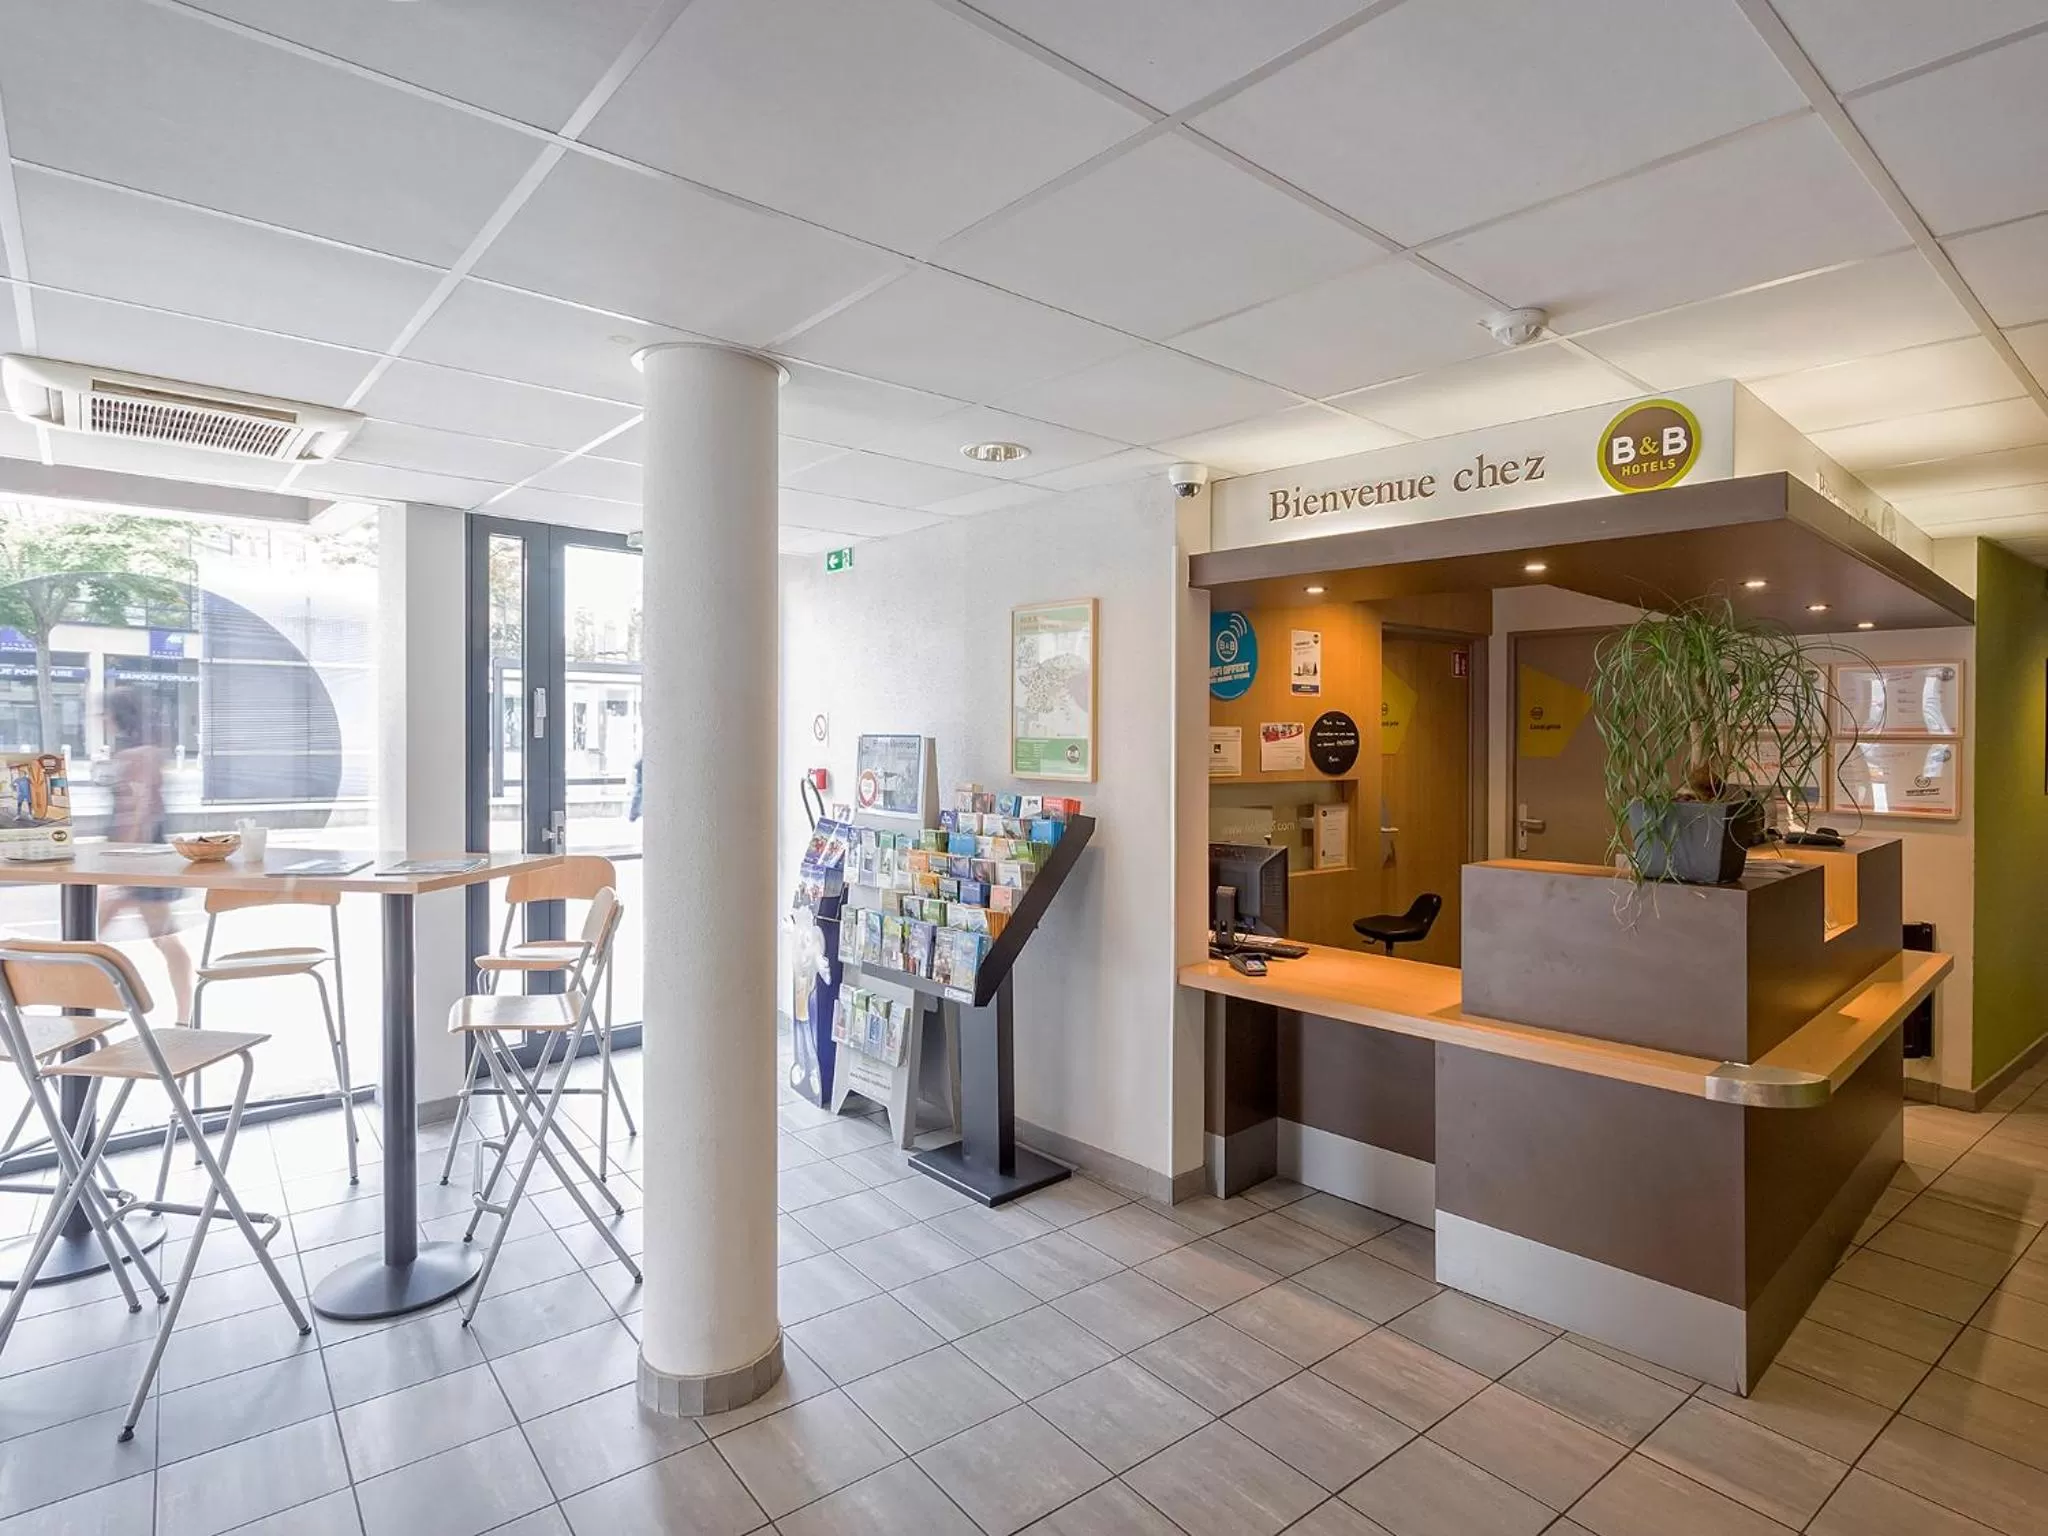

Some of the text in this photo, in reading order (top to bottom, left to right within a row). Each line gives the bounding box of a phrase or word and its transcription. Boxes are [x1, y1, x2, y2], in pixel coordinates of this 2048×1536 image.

[1269, 453, 1546, 522] Bienvenue chez
[1621, 458, 1677, 477] HOTELS
